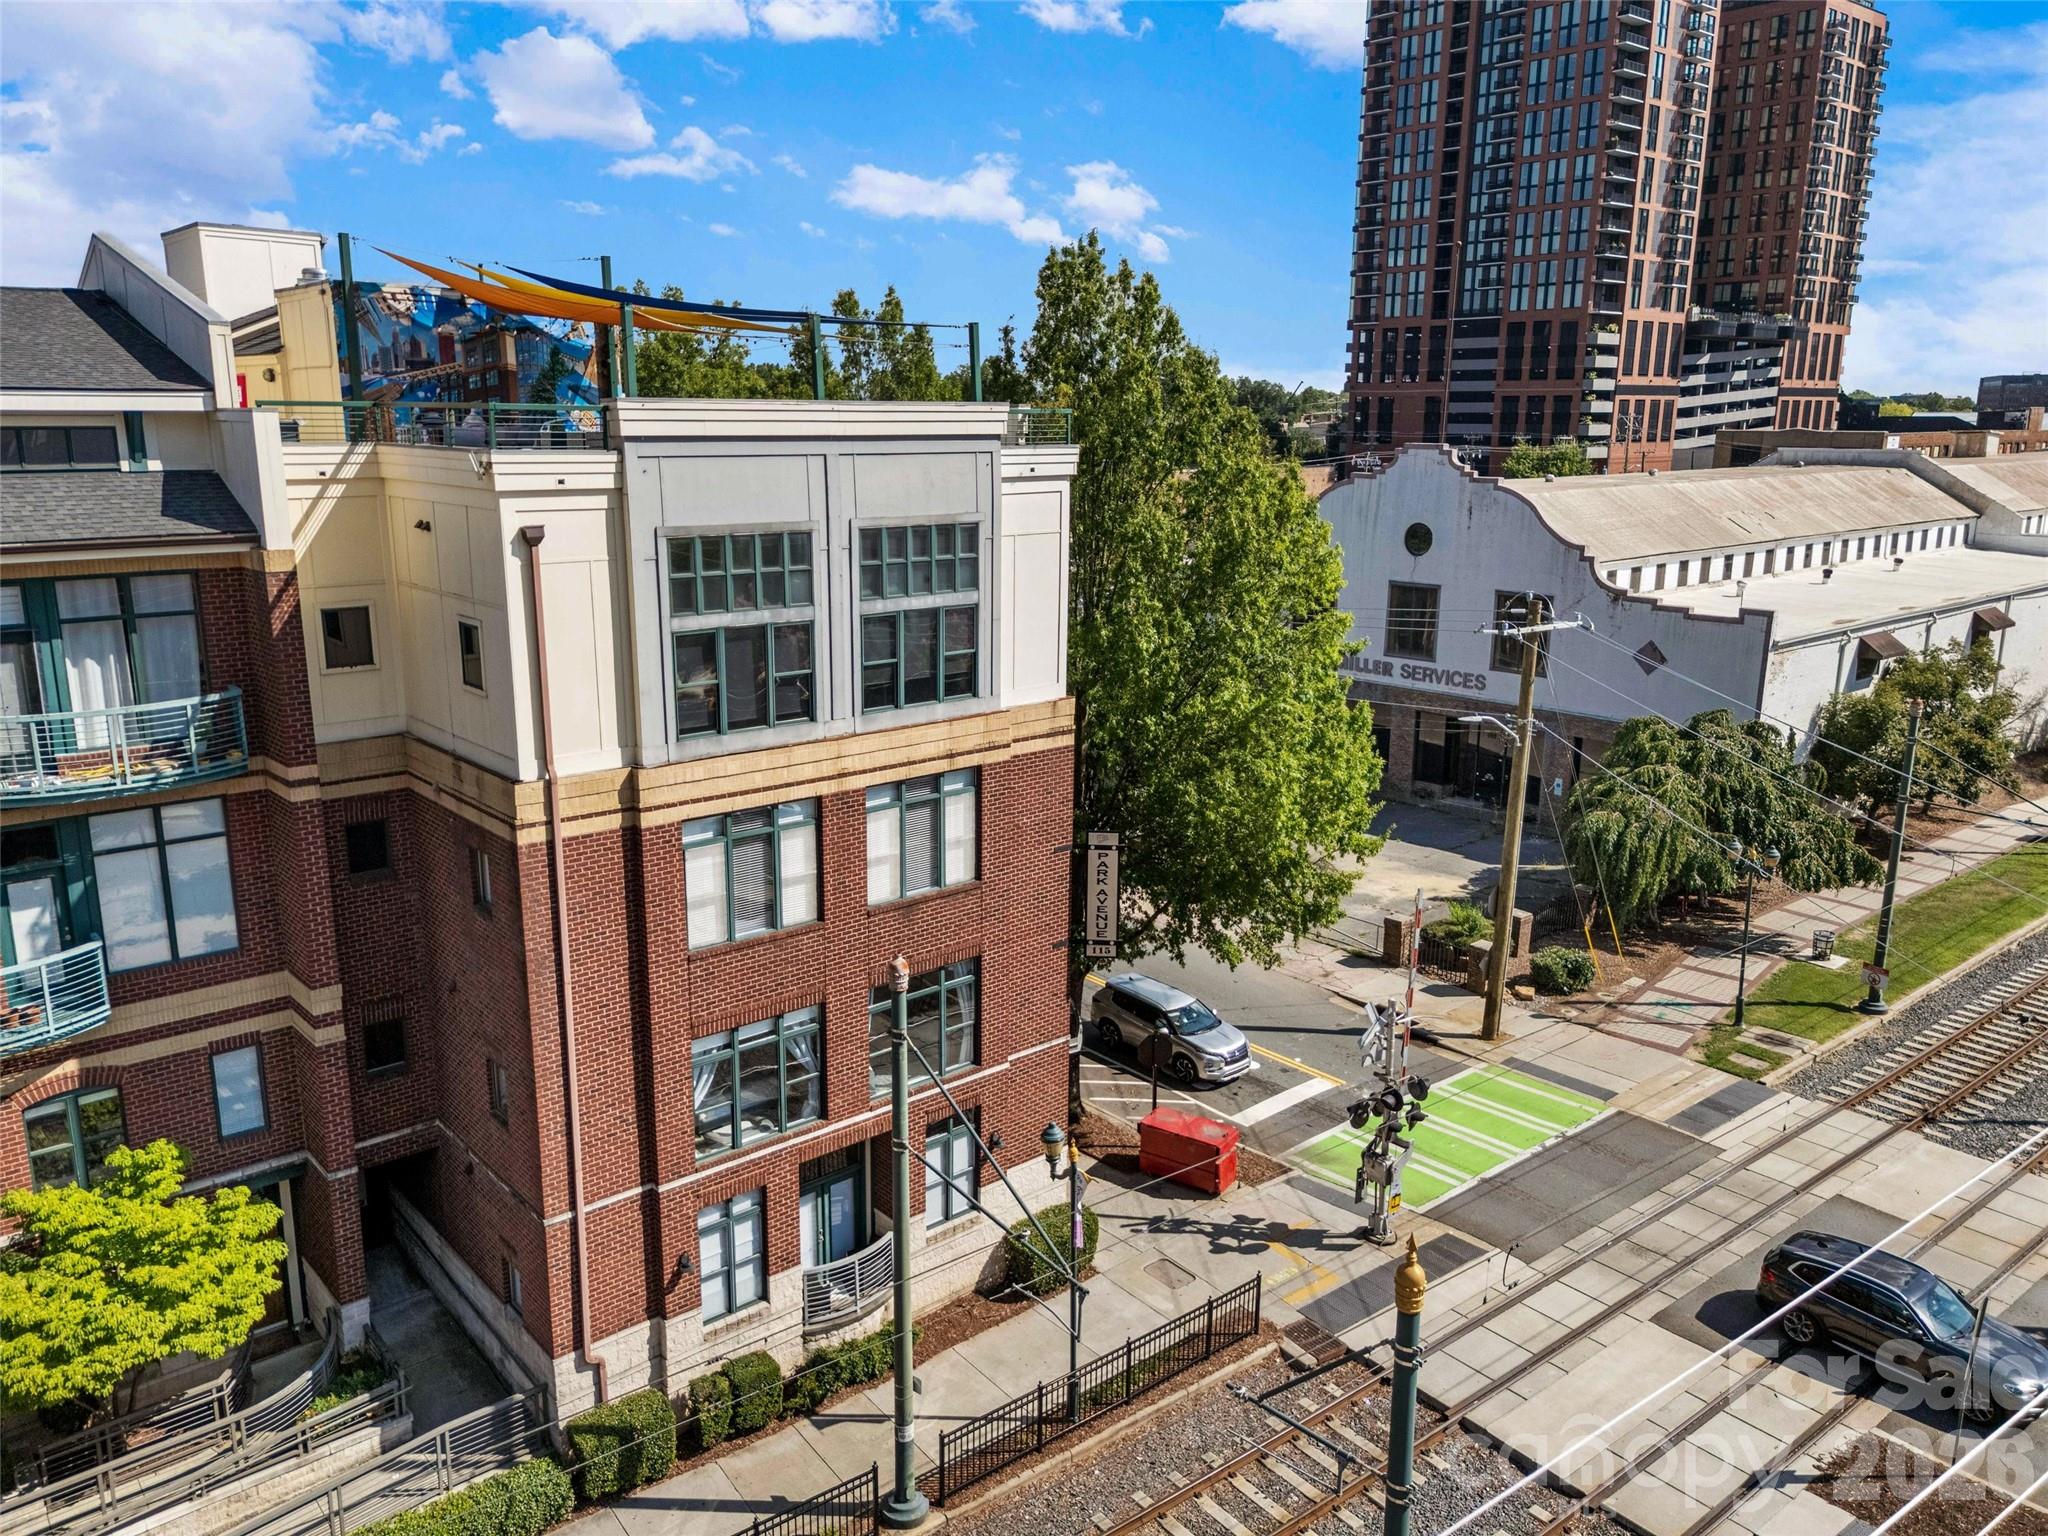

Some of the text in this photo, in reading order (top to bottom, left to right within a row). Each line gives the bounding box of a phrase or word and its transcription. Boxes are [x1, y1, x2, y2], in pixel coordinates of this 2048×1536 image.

[1400, 663, 1487, 691] SERVICES
[1096, 852, 1108, 938] PARK AVENUE
[1092, 946, 1111, 954] 115
